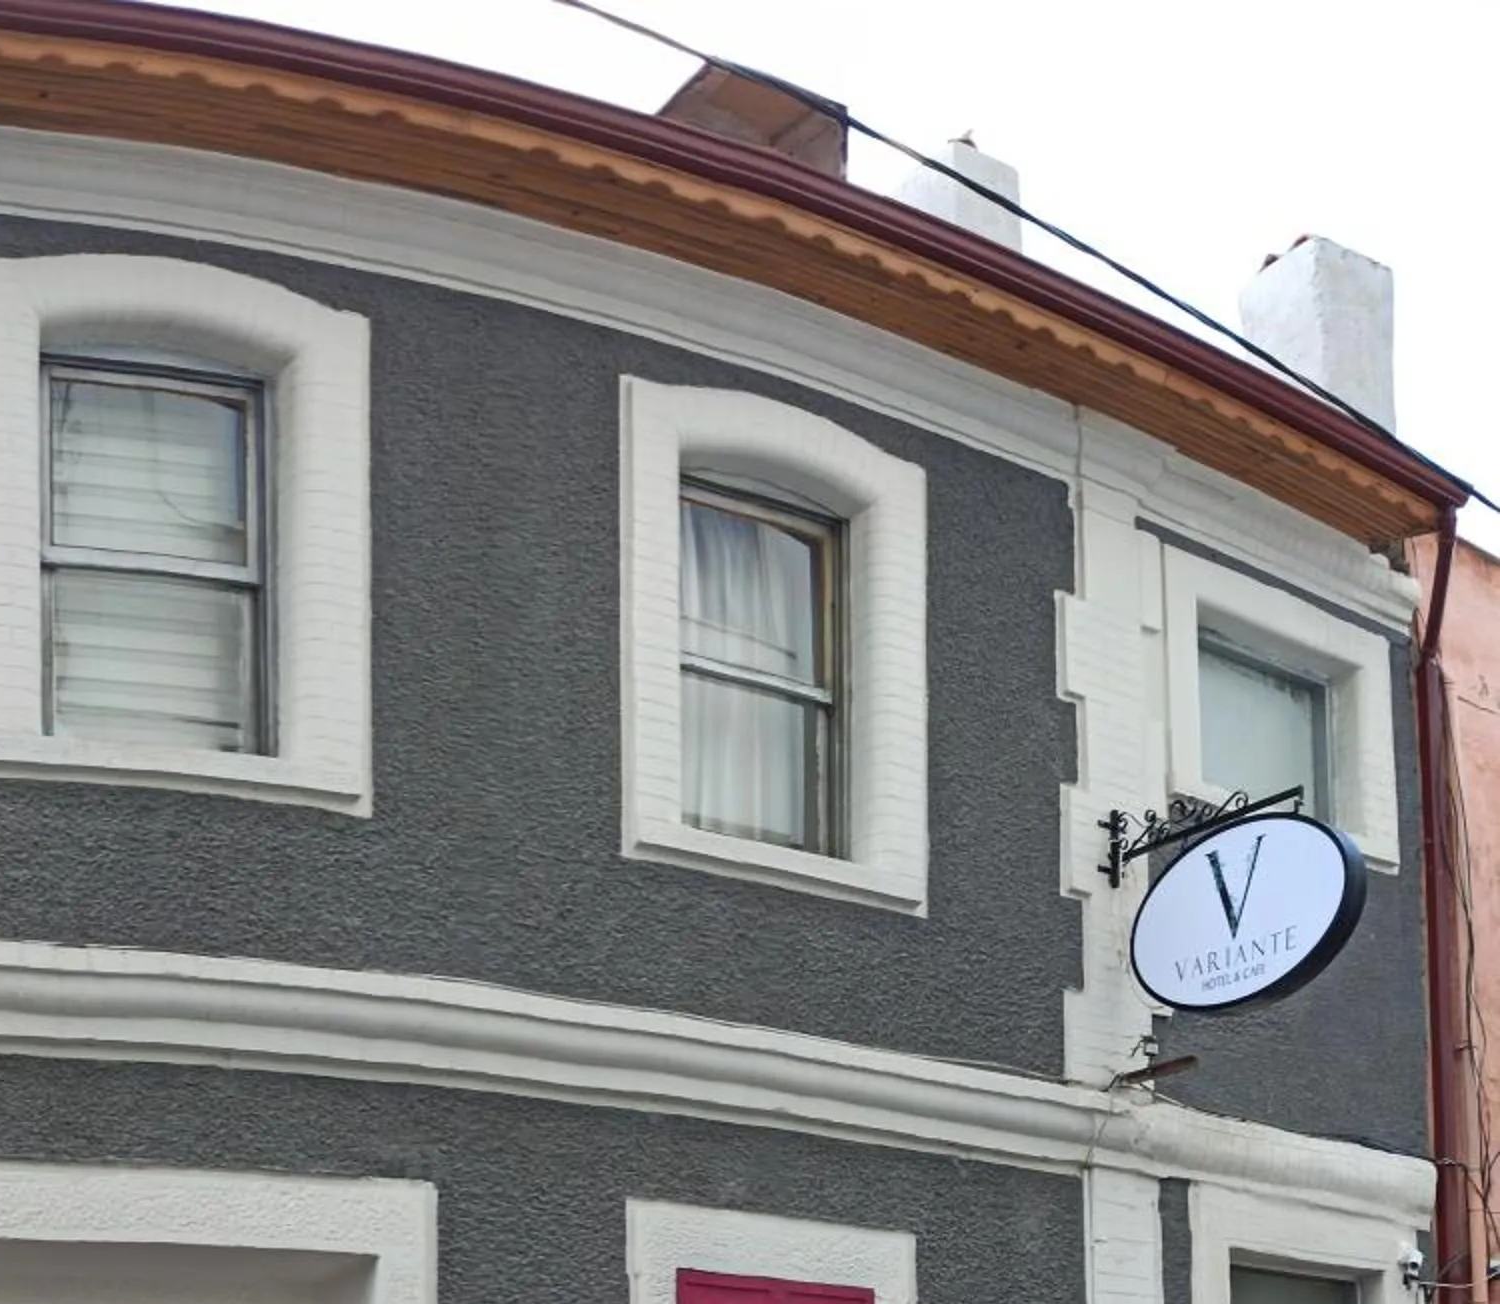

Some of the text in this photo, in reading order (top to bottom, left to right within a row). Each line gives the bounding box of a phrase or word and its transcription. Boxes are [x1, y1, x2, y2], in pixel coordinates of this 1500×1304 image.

[1205, 833, 1266, 939] V
[1175, 926, 1297, 981] VARIANTE
[1202, 973, 1231, 991] HOTEL
